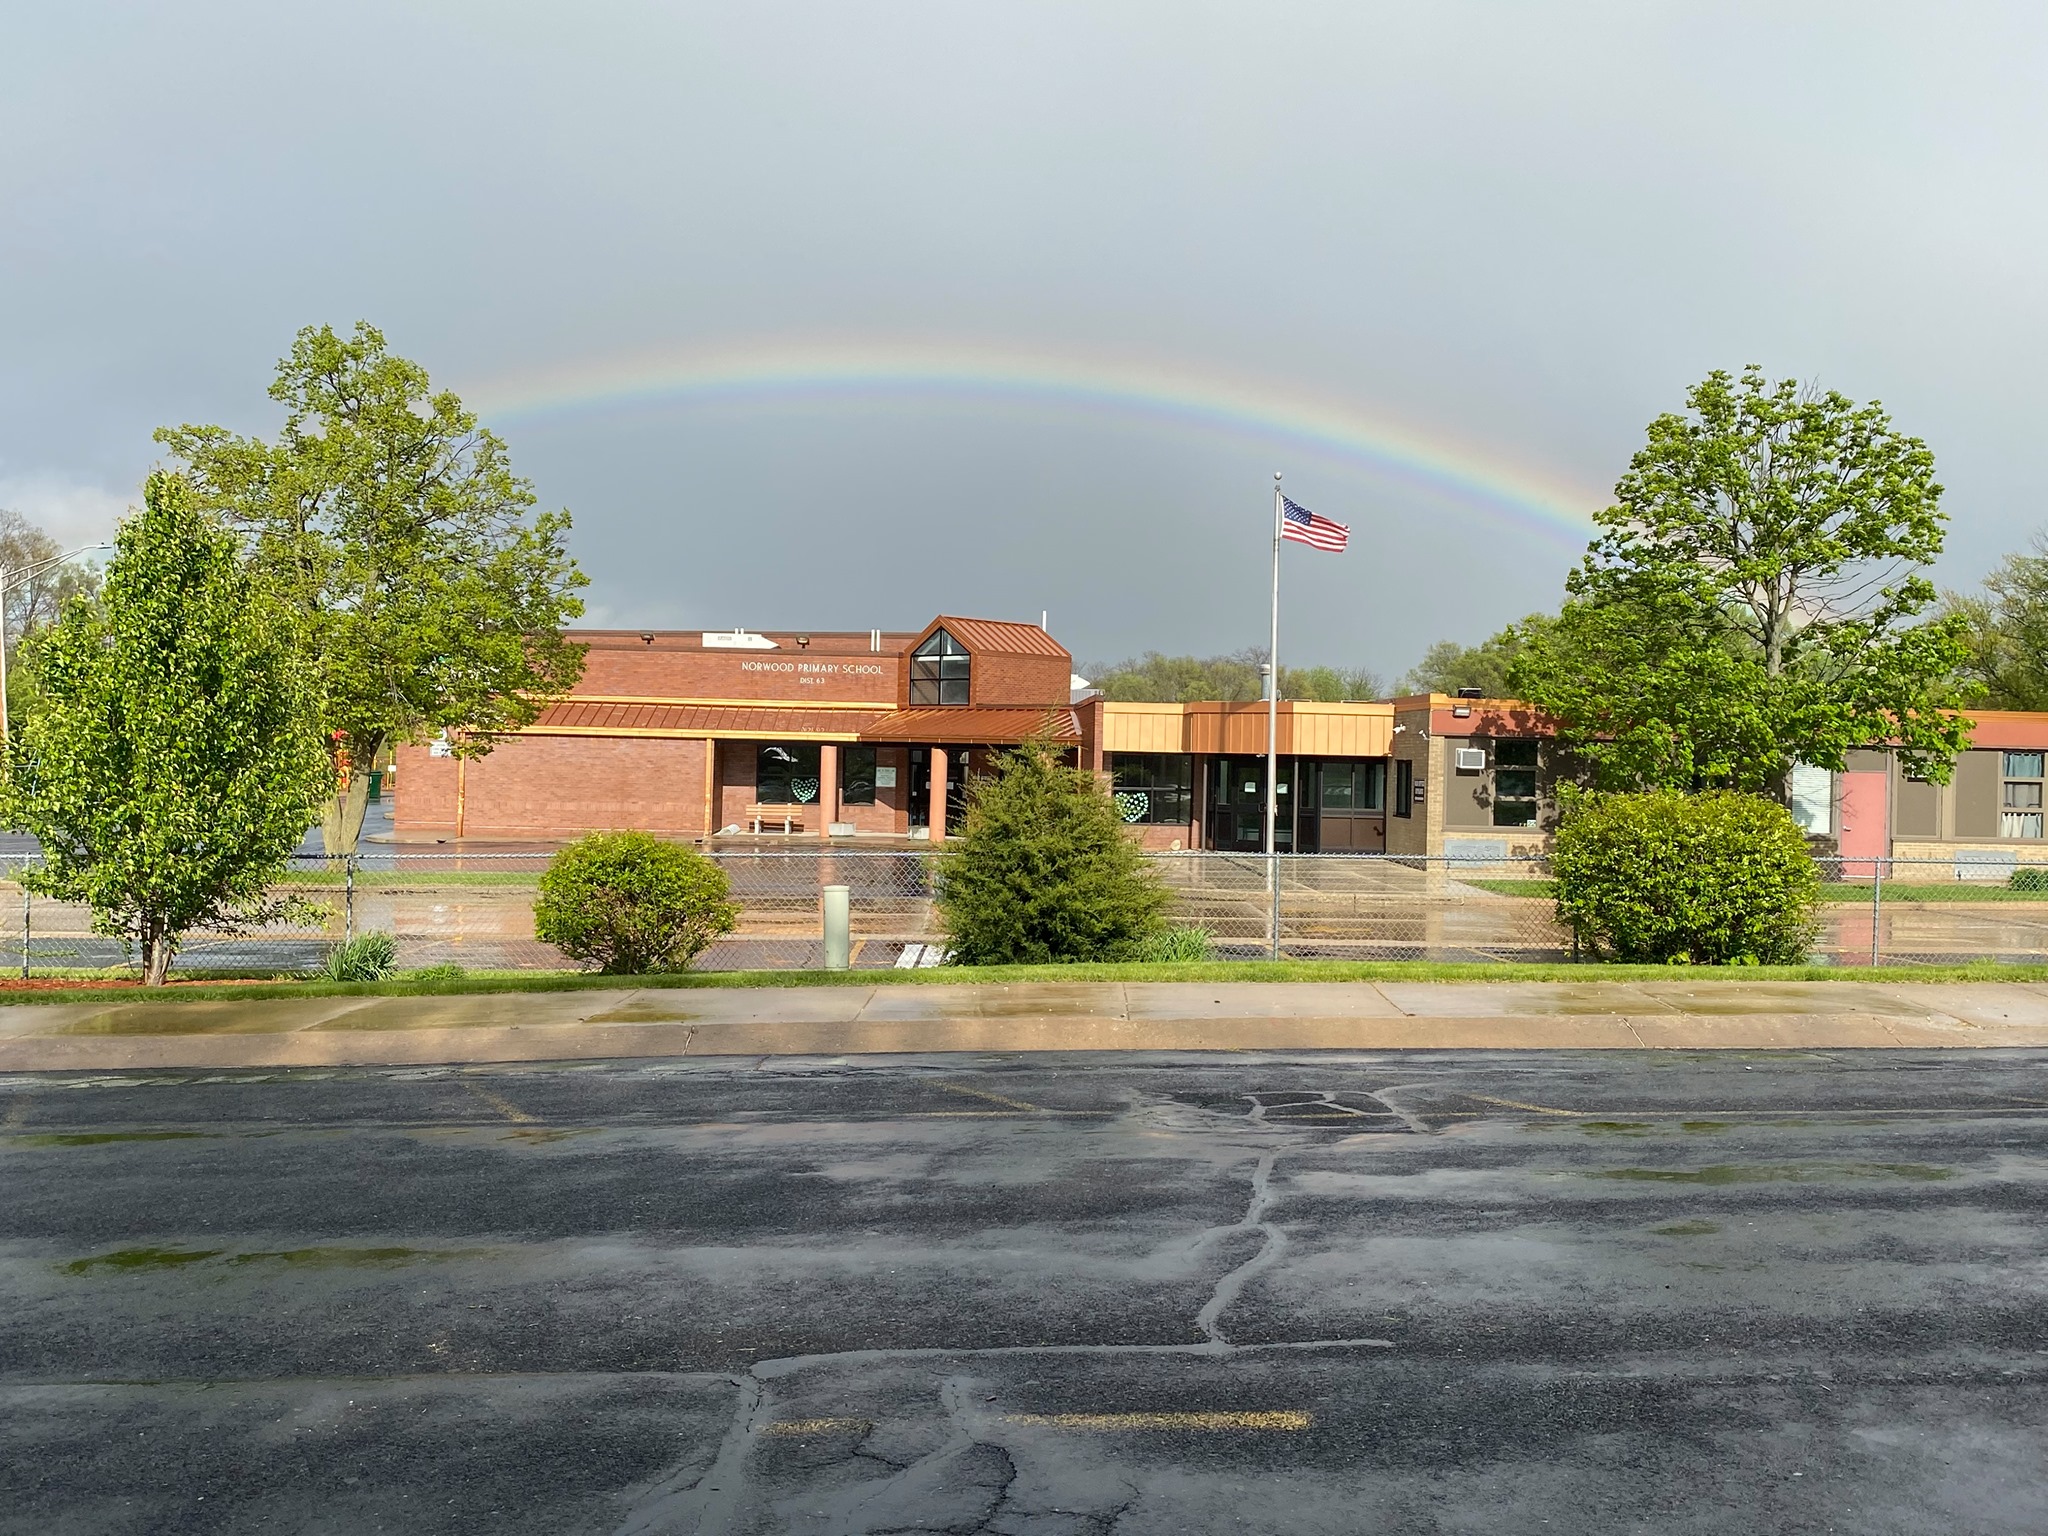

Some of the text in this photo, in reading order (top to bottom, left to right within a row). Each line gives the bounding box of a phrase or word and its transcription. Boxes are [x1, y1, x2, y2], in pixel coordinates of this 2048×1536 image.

[741, 661, 884, 675] NORWOOD PRIMARY SCHOOL
[816, 677, 825, 685] 63
